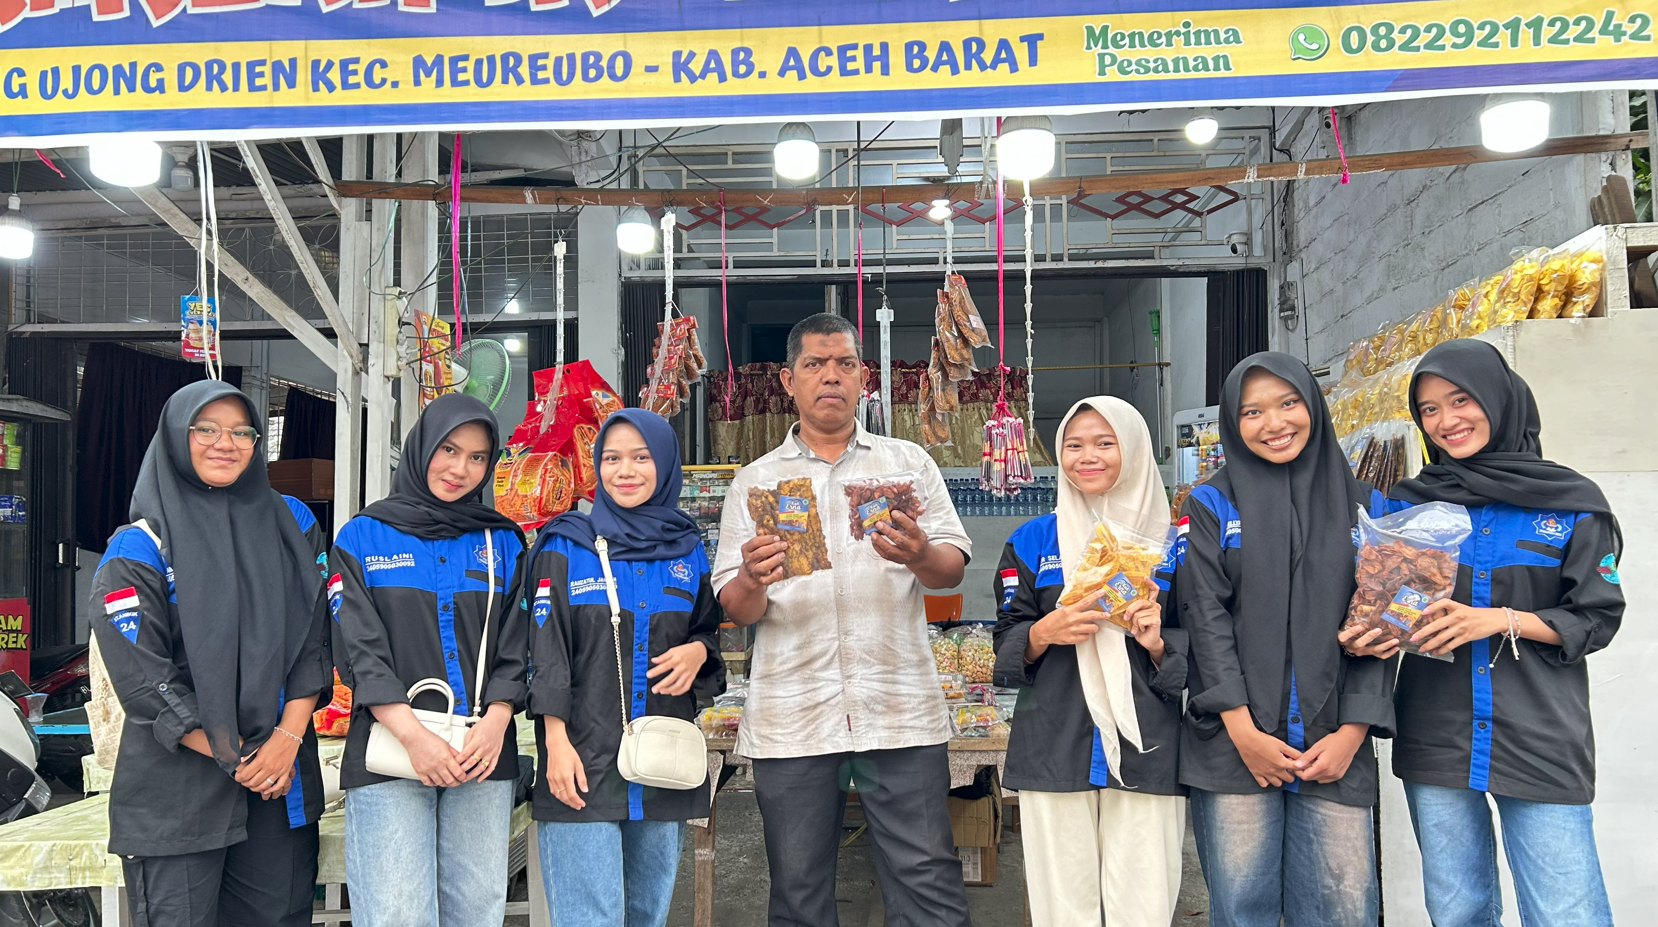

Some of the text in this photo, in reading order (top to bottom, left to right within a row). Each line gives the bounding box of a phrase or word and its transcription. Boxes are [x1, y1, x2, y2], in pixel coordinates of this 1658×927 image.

[1085, 21, 1242, 51] Menerima
[1341, 11, 1652, 55] 082292112242
[39, 62, 165, 99] UJONG
[177, 58, 298, 93] DRIEN
[311, 57, 399, 93] KEC.
[413, 51, 632, 89] MEUREUBO
[672, 47, 767, 84] KAB.
[778, 41, 890, 81] ACEH
[904, 33, 1044, 76] BARAT
[1097, 52, 1232, 77] Pesanan
[365, 552, 413, 563] RUSLAINI
[534, 606, 548, 617] 24
[120, 620, 137, 632] 24
